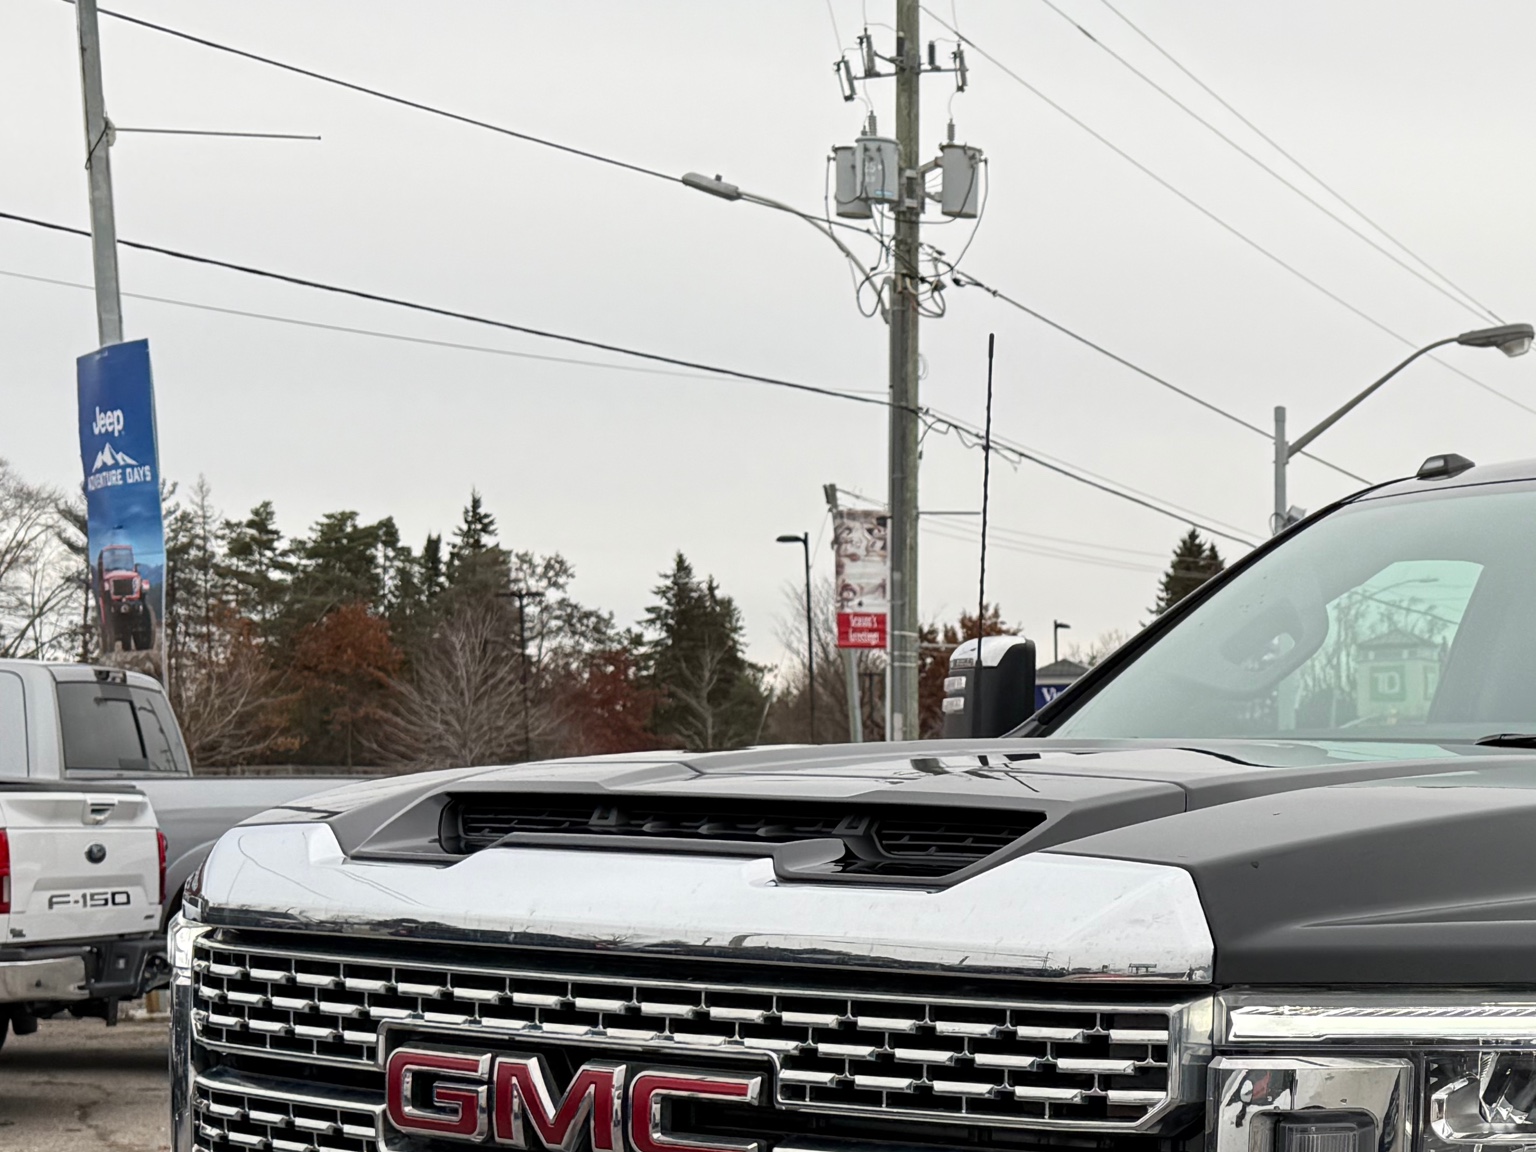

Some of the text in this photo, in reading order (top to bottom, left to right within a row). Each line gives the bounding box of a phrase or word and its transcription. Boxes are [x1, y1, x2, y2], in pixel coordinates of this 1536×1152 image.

[92, 405, 124, 437] Jeep
[88, 465, 152, 491] ADVENTURE DAYS
[48, 891, 131, 910] F-150
